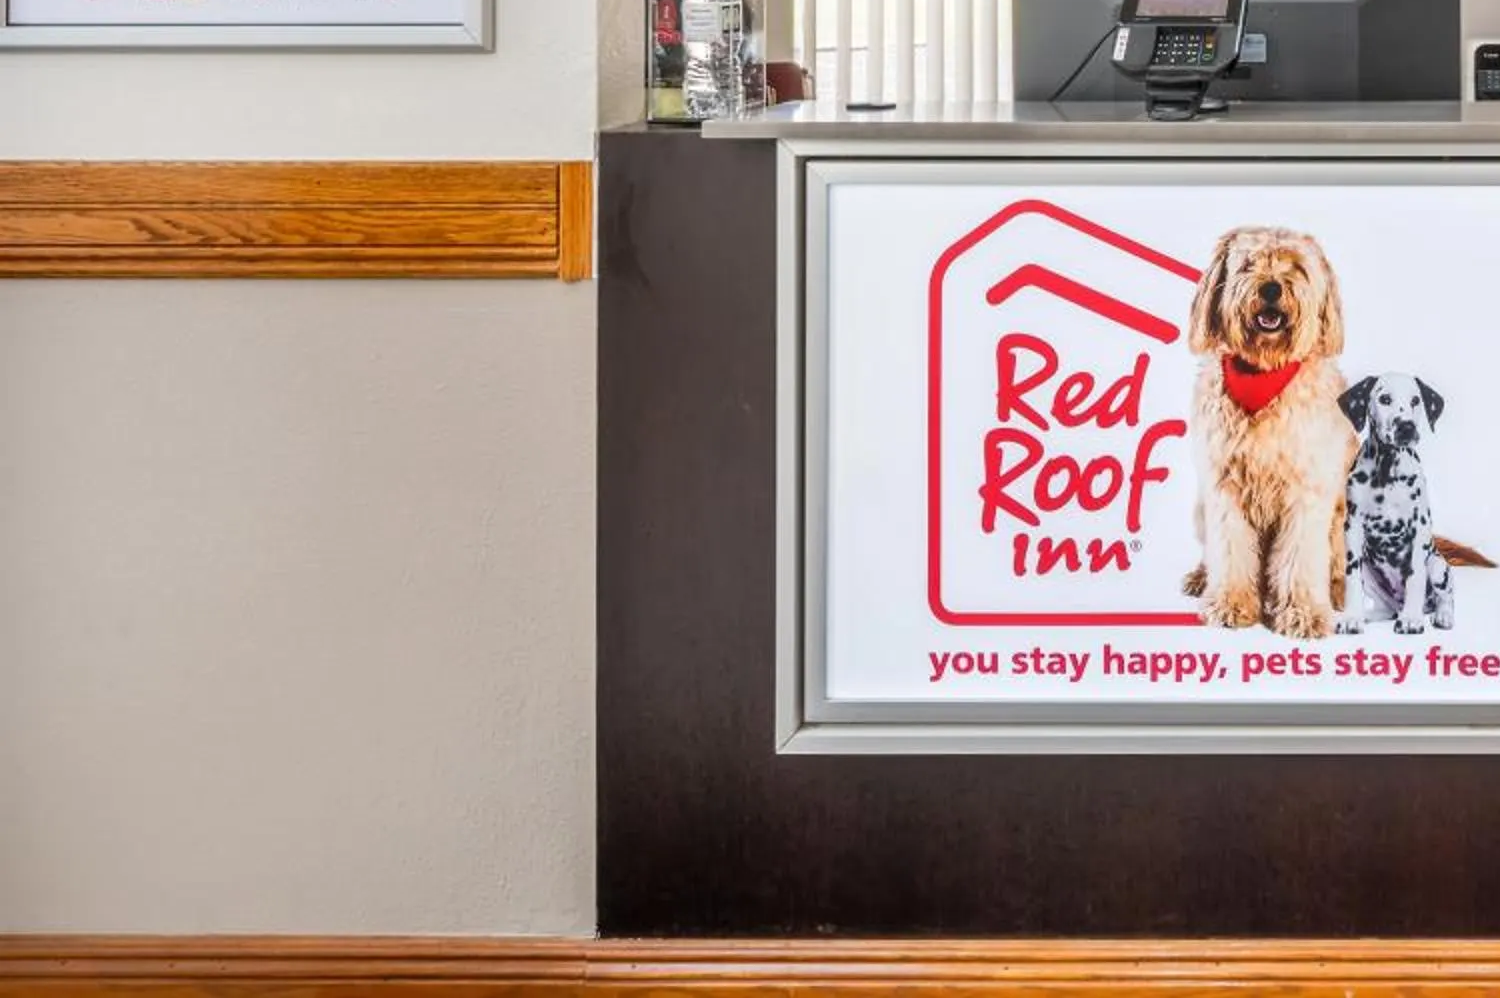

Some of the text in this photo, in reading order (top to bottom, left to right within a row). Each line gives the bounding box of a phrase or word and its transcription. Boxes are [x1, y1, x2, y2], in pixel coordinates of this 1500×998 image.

[995, 332, 1151, 432] Red
[979, 419, 1188, 532] Roof
[928, 651, 999, 683] you
[1012, 648, 1090, 684] stay
[1102, 645, 1227, 684] happy,
[1241, 648, 1322, 684] pets
[1335, 649, 1412, 684] stay
